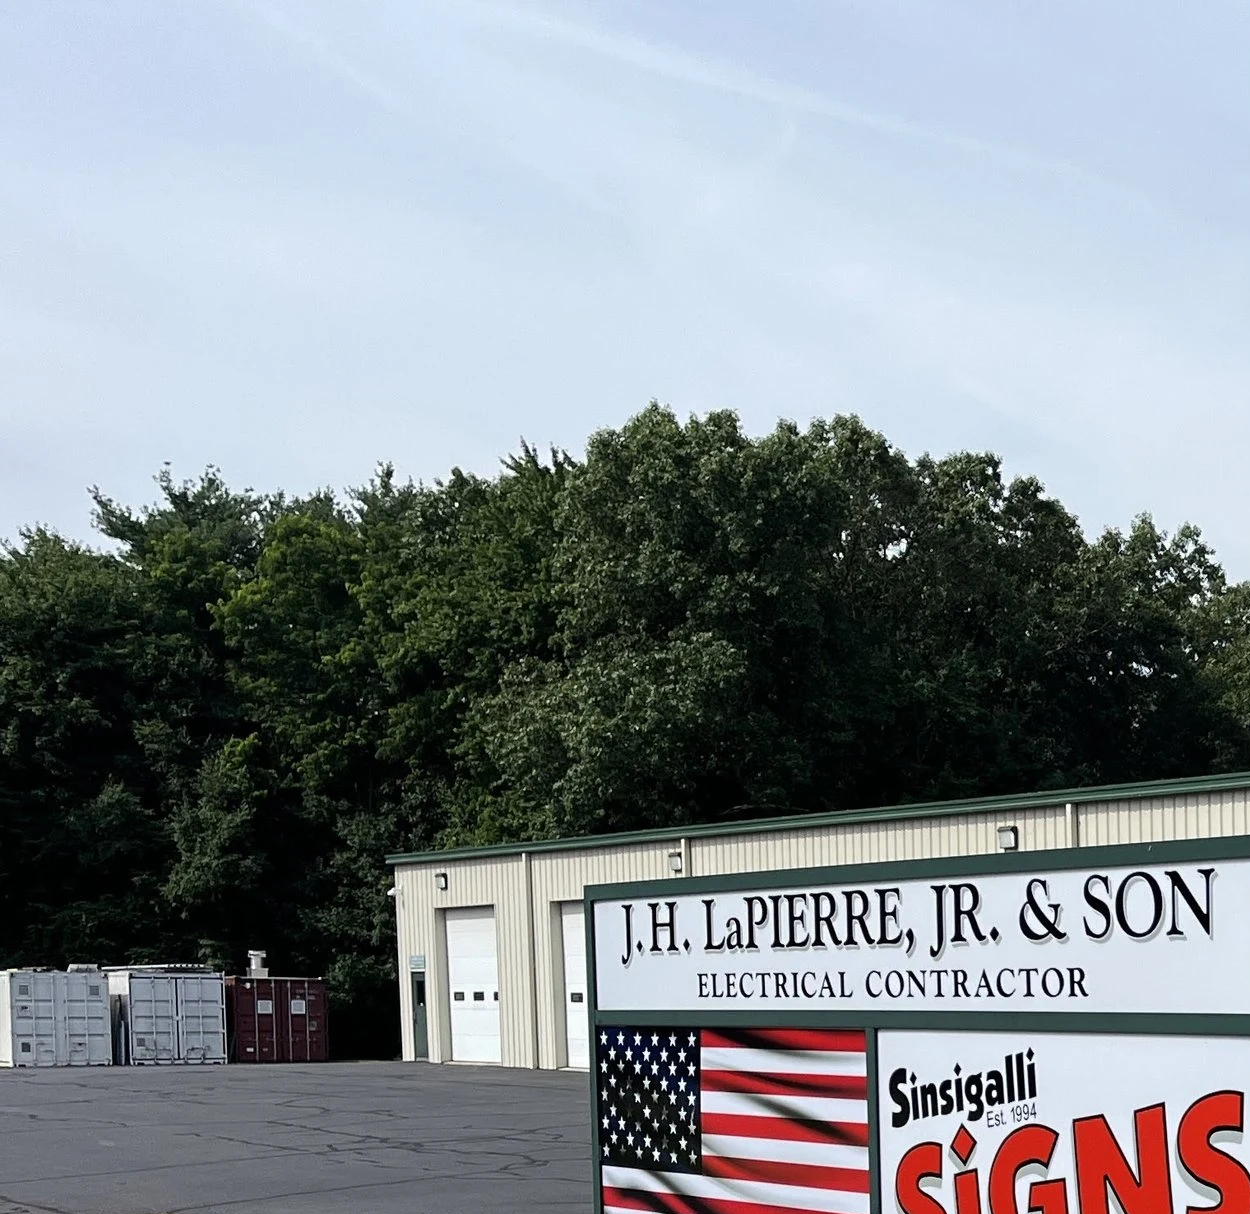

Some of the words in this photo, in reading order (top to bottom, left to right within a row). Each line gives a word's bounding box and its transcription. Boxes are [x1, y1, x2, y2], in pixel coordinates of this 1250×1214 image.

[621, 902, 691, 965] J.H.
[702, 888, 914, 953] LaPIERRE,
[930, 883, 1000, 958] JR.
[1019, 878, 1067, 940] &
[1083, 868, 1215, 938] SON
[697, 971, 853, 998] ELECTRICAL
[865, 967, 1089, 998] CONTRACTOR
[889, 1047, 1037, 1128] Sinsigalli
[986, 1111, 1008, 1128] Est.
[1010, 1103, 1037, 1124] 1994
